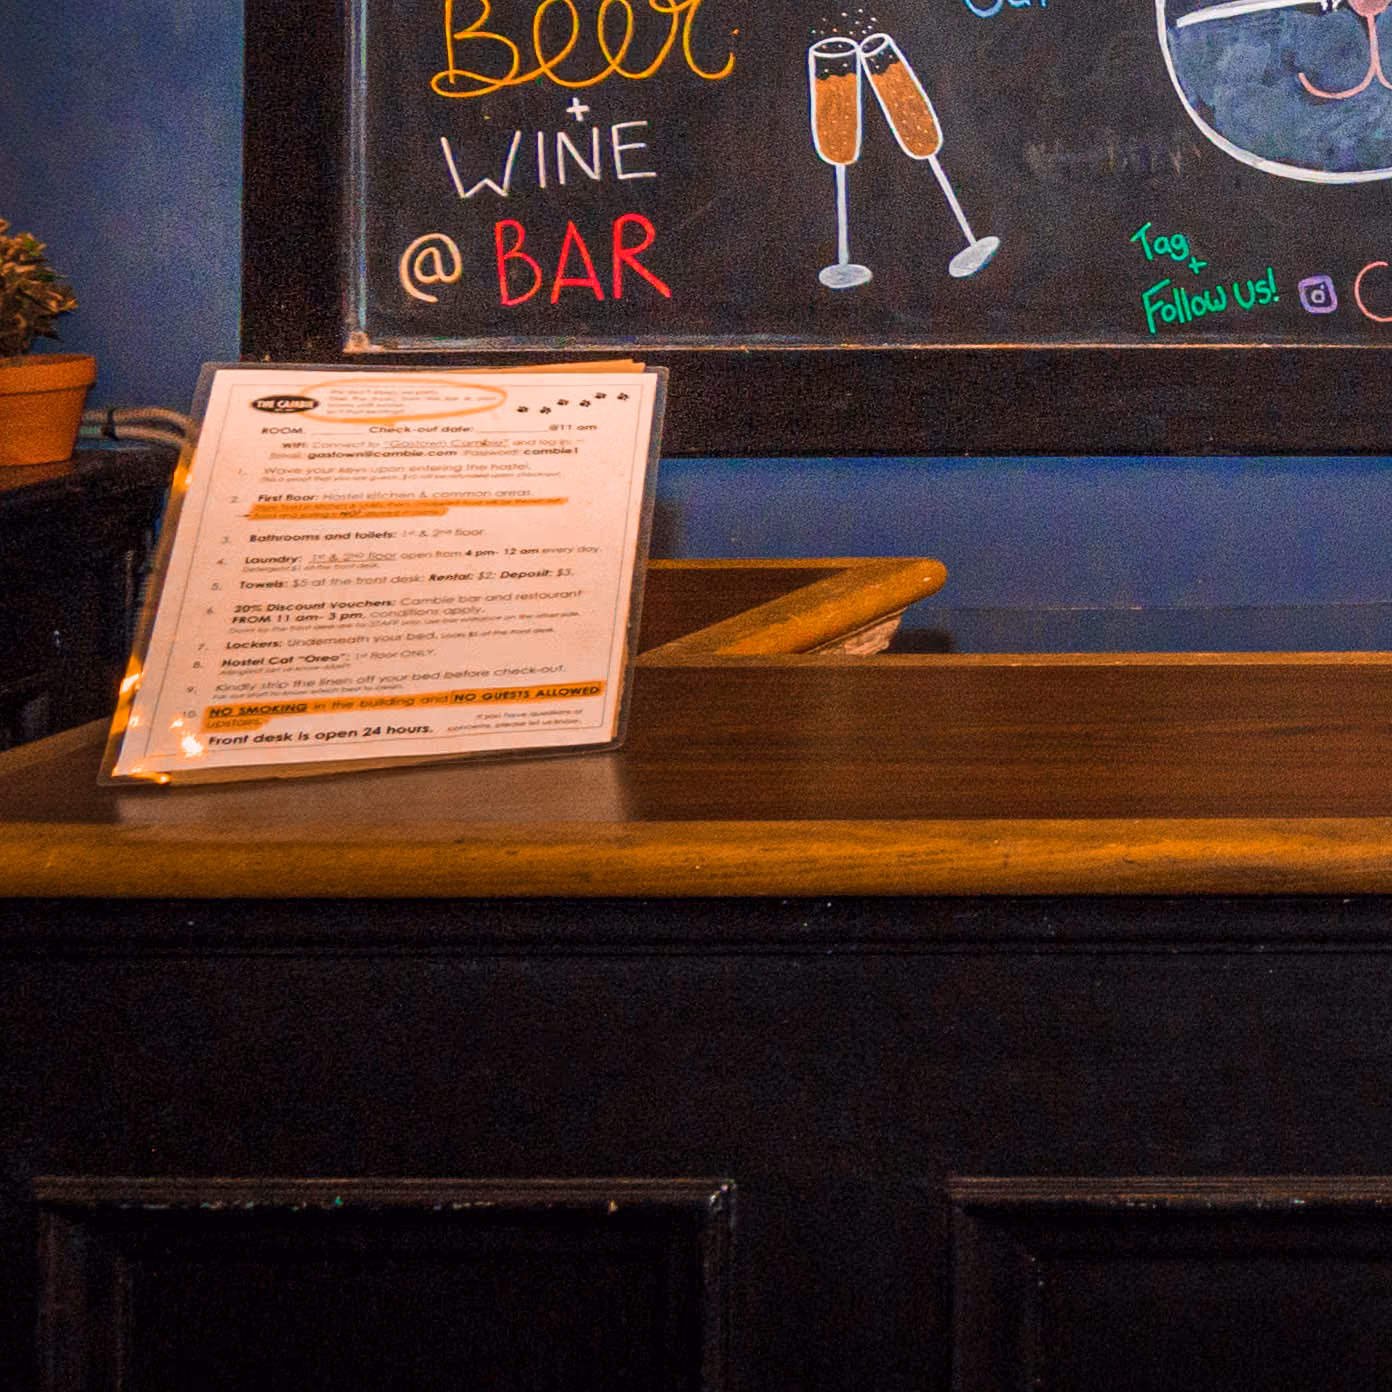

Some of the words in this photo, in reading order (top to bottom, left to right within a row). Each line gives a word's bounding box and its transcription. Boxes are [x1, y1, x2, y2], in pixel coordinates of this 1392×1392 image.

[441, 121, 657, 198] WINE
[1131, 222, 1190, 273] Tag
[400, 234, 462, 302] @
[495, 213, 670, 306] BAR
[1141, 280, 1227, 336] Follow
[1229, 267, 1280, 312] us!
[261, 426, 303, 435] ROOM
[369, 425, 438, 434] Check-out
[441, 425, 474, 434] date:
[257, 493, 283, 503] First
[249, 532, 320, 543] Bathrooms
[323, 531, 352, 541] and
[503, 547, 518, 556] 12
[519, 547, 541, 555] am
[291, 578, 309, 589] $5
[329, 576, 353, 586] the
[354, 575, 388, 586] front
[265, 602, 326, 613] Discount
[400, 596, 456, 607] Cambie
[458, 595, 481, 604] bar
[484, 593, 512, 603] and
[231, 614, 272, 625] FROM
[276, 614, 290, 624] 11
[328, 612, 337, 622] 3
[226, 639, 283, 651] Lockers:
[220, 657, 265, 668] Hostel
[268, 655, 295, 666] Cat
[412, 671, 441, 681] bed
[443, 669, 491, 680] before
[208, 706, 233, 718] NO
[239, 702, 309, 715] SMOKING
[454, 692, 478, 704] NO
[481, 690, 531, 702] GUESTS
[535, 685, 602, 698] ALLOWED
[208, 733, 250, 746] Front
[252, 731, 293, 744] desk
[297, 730, 311, 742] is
[314, 728, 358, 743] open
[362, 725, 382, 738] 24
[386, 723, 434, 736] hours.
